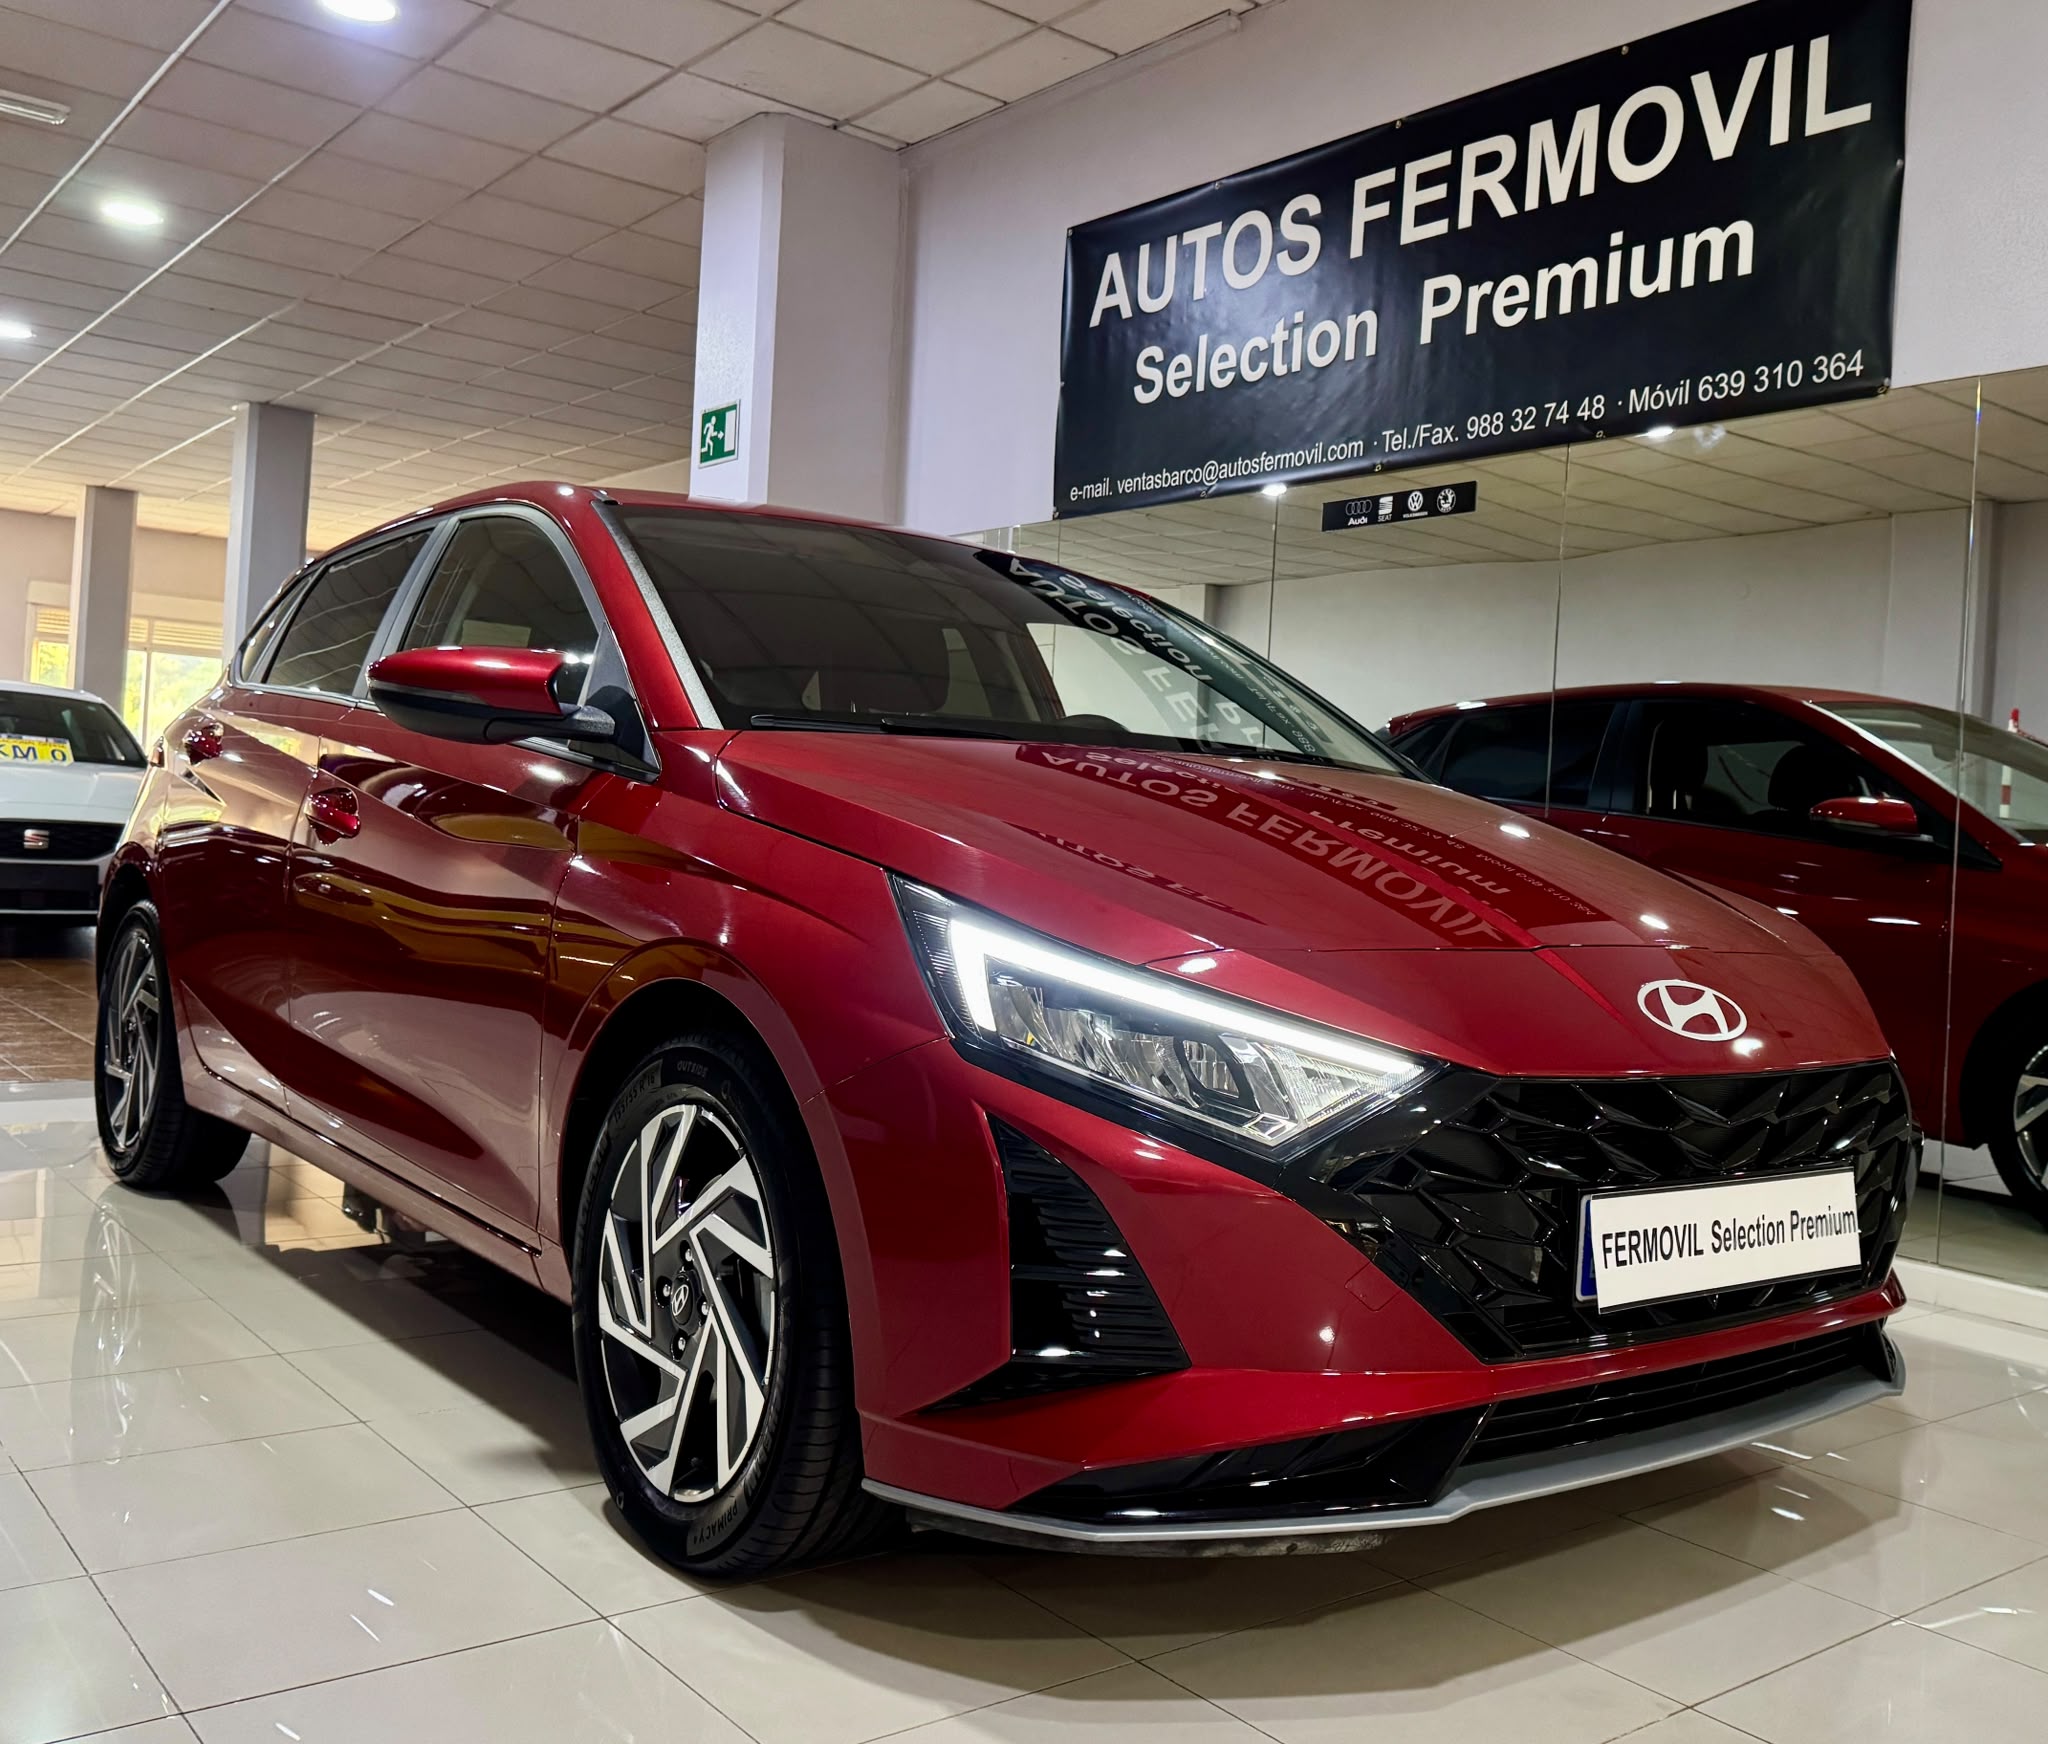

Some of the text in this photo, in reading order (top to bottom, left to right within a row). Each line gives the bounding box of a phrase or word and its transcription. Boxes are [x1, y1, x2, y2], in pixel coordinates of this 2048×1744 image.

[1090, 36, 1872, 328] AUTOS FERMOVIL
[1134, 220, 1754, 404] Selection Premium
[1071, 478, 1113, 501] e-mail.
[1118, 440, 1363, 494] ventasbarco@autosfermovil.com
[1467, 412, 1504, 440] 988
[1511, 407, 1537, 433] 32
[1544, 400, 1570, 427] 74
[1577, 395, 1605, 420] 48
[1699, 370, 1746, 402] 639
[1754, 360, 1803, 392] 310
[1812, 349, 1864, 383] 364
[1348, 516, 1368, 526] Audi
[1378, 514, 1393, 522] SEAT
[1602, 1205, 1857, 1270] FERMOVIL Selection Premium
[699, 1499, 738, 1545] PRIMACY
